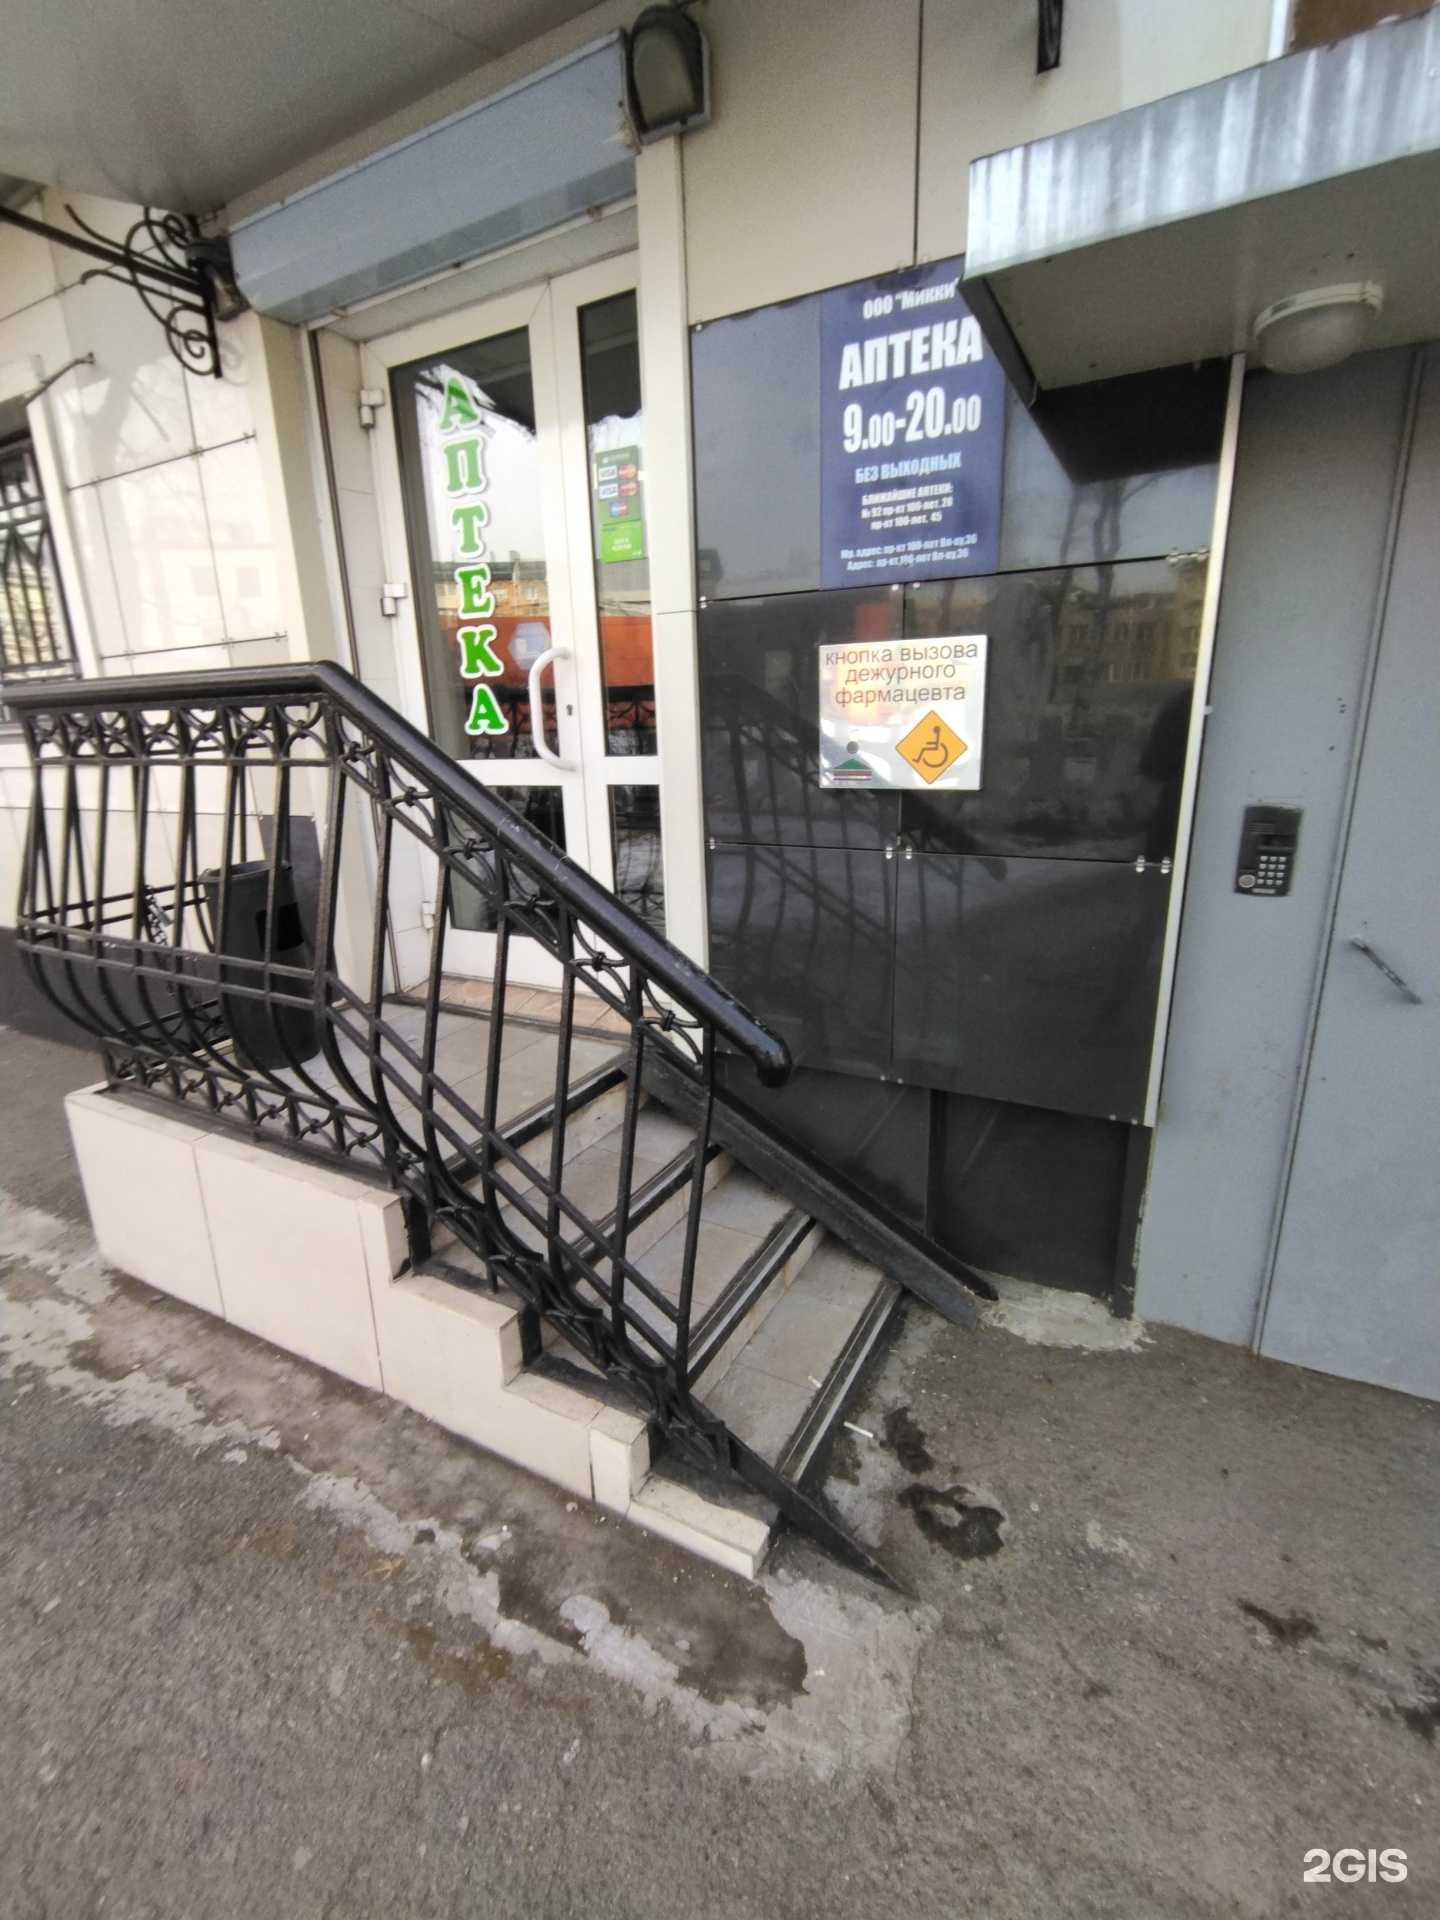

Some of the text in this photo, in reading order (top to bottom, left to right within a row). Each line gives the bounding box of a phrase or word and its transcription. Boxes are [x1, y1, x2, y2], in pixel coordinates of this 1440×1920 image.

[863, 294, 893, 319] ООО
[838, 314, 984, 390] АПТЕКА
[843, 386, 982, 453] 9.00-20.00
[855, 451, 962, 484] БЕЗ ВЫХОДНЫХ
[438, 376, 508, 735] АПТЕКА
[825, 643, 979, 666] кнопка вызова
[844, 664, 956, 685] дежурного
[835, 685, 966, 708] фармацевта
